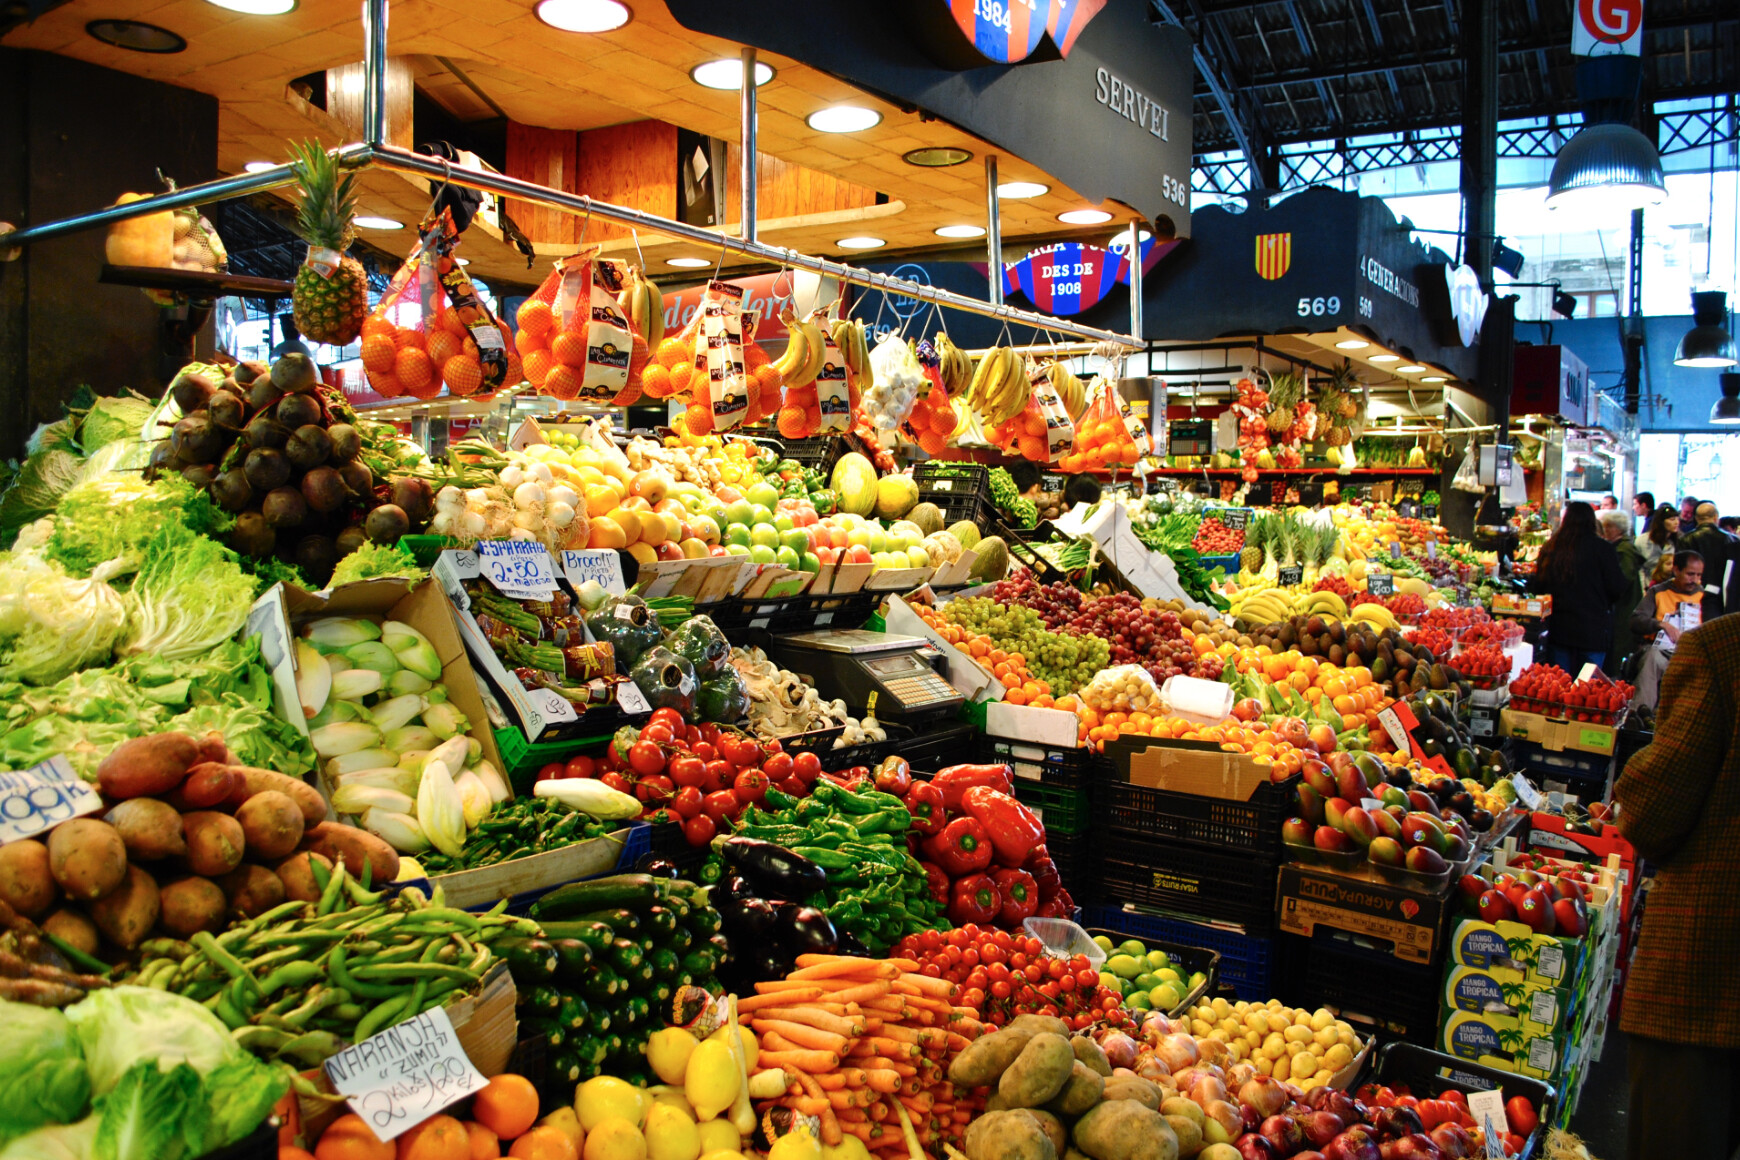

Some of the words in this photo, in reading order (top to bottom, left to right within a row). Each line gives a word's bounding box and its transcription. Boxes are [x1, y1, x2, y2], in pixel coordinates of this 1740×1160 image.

[973, 0, 1012, 34] 1984
[1592, 0, 1629, 35] G
[1095, 67, 1169, 142] SERVEI
[1162, 174, 1185, 207] 536
[1042, 265, 1070, 278] DES
[1073, 262, 1093, 276] DE
[1050, 282, 1081, 296] 1908
[1360, 255, 1366, 277] 4
[1367, 258, 1419, 308] GENERACIONS
[1297, 296, 1340, 317] 569
[1359, 296, 1372, 319] 569
[1467, 941, 1505, 953] TROPICAL
[1468, 934, 1492, 943] MANGO
[1461, 985, 1499, 997] TROPICAL
[1463, 978, 1486, 986] MANGO
[1459, 1032, 1496, 1045] TROPICAL
[1460, 1025, 1483, 1034] MANGO
[362, 1090, 407, 1127] 2
